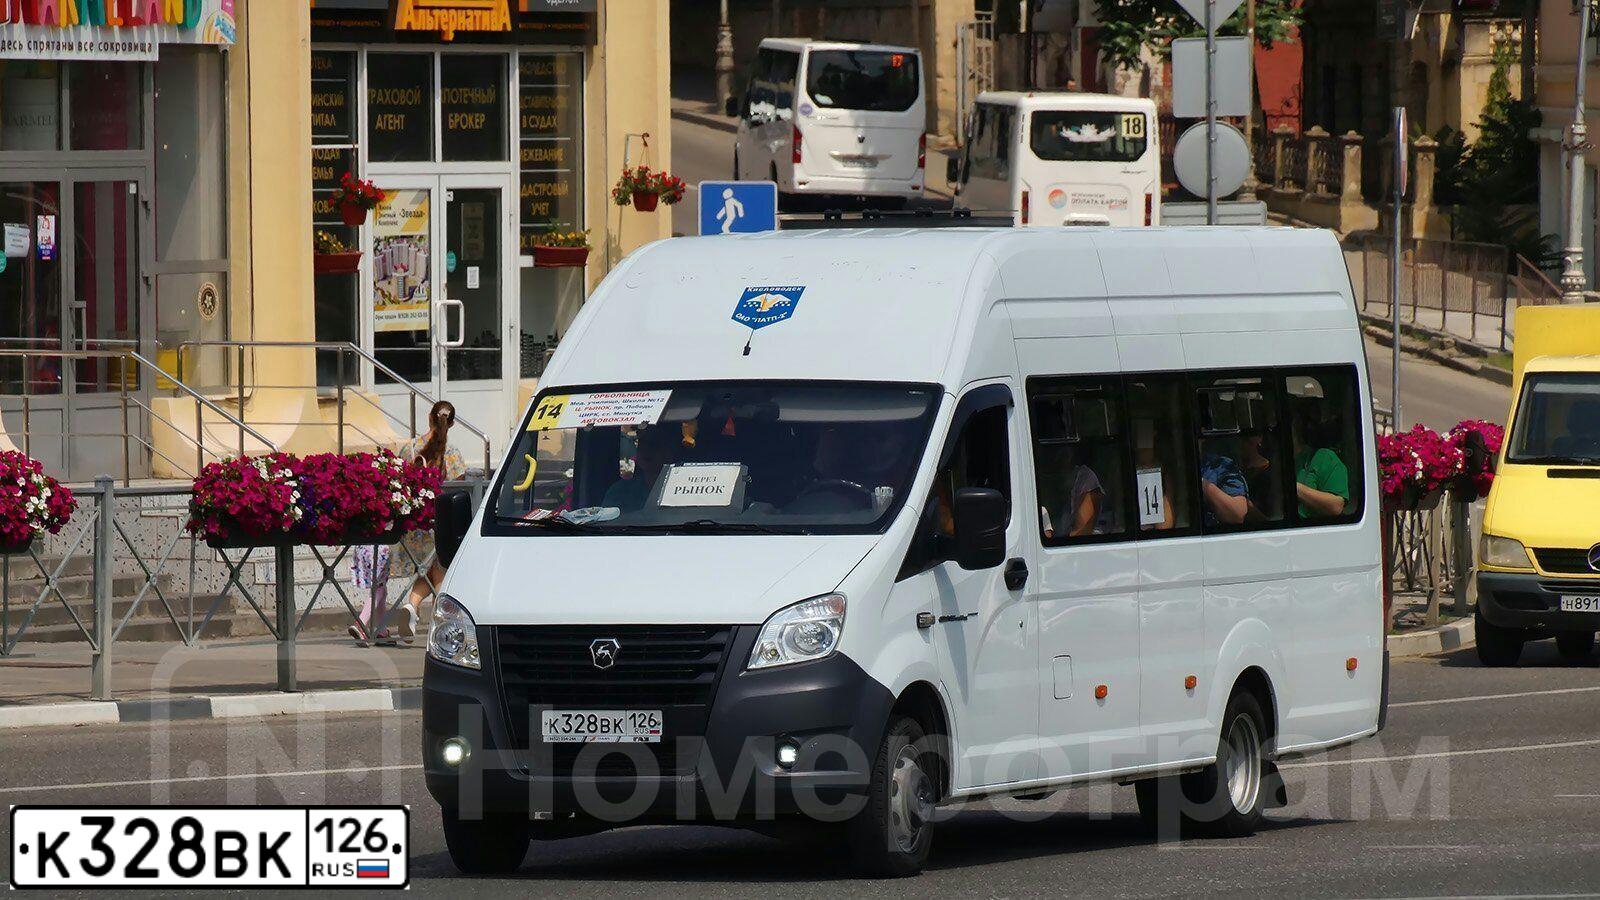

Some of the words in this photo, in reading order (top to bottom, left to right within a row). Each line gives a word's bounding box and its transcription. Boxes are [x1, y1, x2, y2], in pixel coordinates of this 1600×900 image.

[27, 40, 74, 53] спрятаны
[78, 41, 94, 51] все
[98, 41, 152, 54] сокровища
[376, 113, 405, 130] АГЕНТ
[449, 113, 485, 130] БРОКЕР
[529, 115, 559, 129] СУДАХ
[1124, 117, 1141, 135] 18
[735, 313, 751, 323] ОАО
[537, 403, 563, 420] 14
[674, 486, 725, 495] РЫНОК
[1144, 485, 1159, 516] 14
[549, 713, 624, 734] К328ВК
[629, 712, 657, 728] 126
[634, 727, 649, 735] RUS
